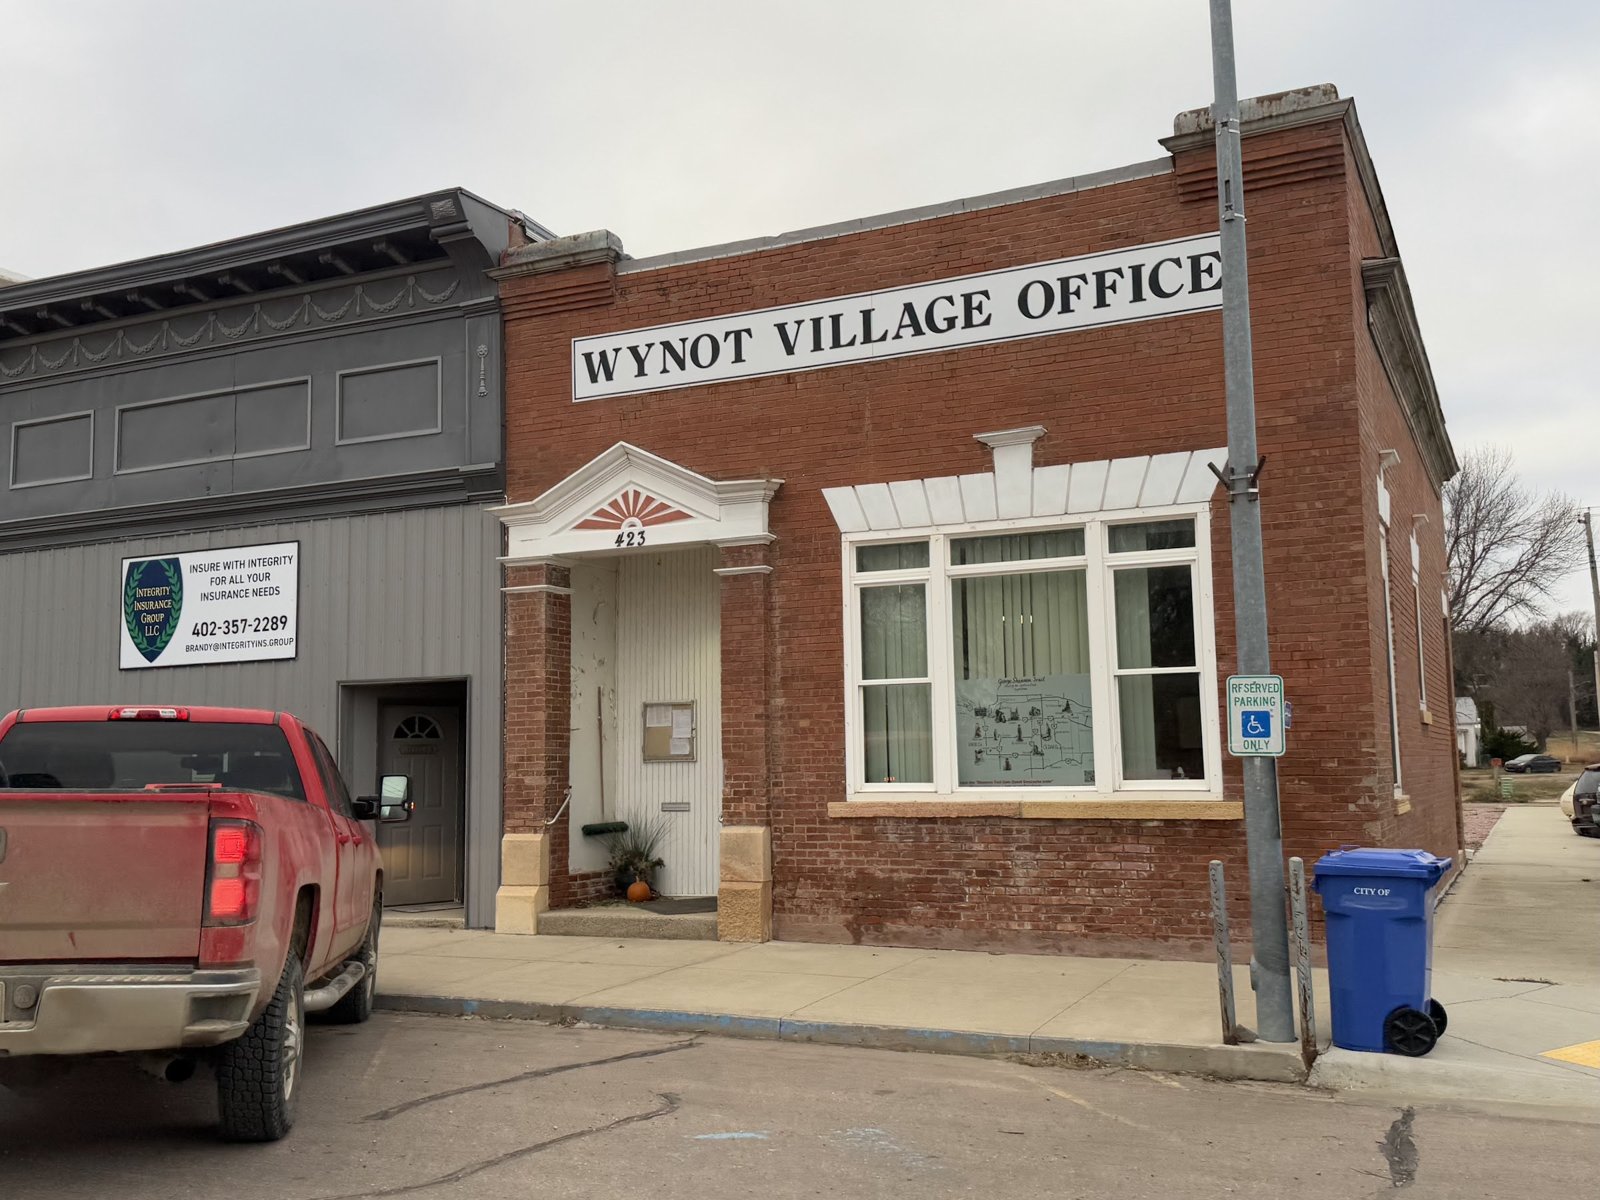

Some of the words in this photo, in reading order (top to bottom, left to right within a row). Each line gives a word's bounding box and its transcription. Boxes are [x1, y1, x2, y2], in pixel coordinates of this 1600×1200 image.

[580, 327, 754, 385] WYNOT
[773, 289, 993, 358] VILLAGE
[1017, 250, 1222, 320] OFFICE
[614, 530, 646, 547] 423
[189, 562, 221, 574] INSURE
[222, 559, 246, 571] WITH
[248, 555, 294, 568] INTEGRITY
[210, 576, 227, 586] FOR
[228, 574, 244, 585] ALL
[246, 572, 271, 583] YOUR
[200, 589, 250, 602] INSURANCE
[252, 586, 280, 597] NEEDS
[145, 625, 160, 637] LLC
[192, 615, 288, 637] 402-357-2289
[185, 637, 294, 653] BRANDY@INTEGRITYINS.GROUP
[1234, 696, 1276, 707] PARKING
[1243, 740, 1270, 750] ONLY
[1353, 887, 1376, 896] CITY
[1377, 888, 1391, 896] OF
